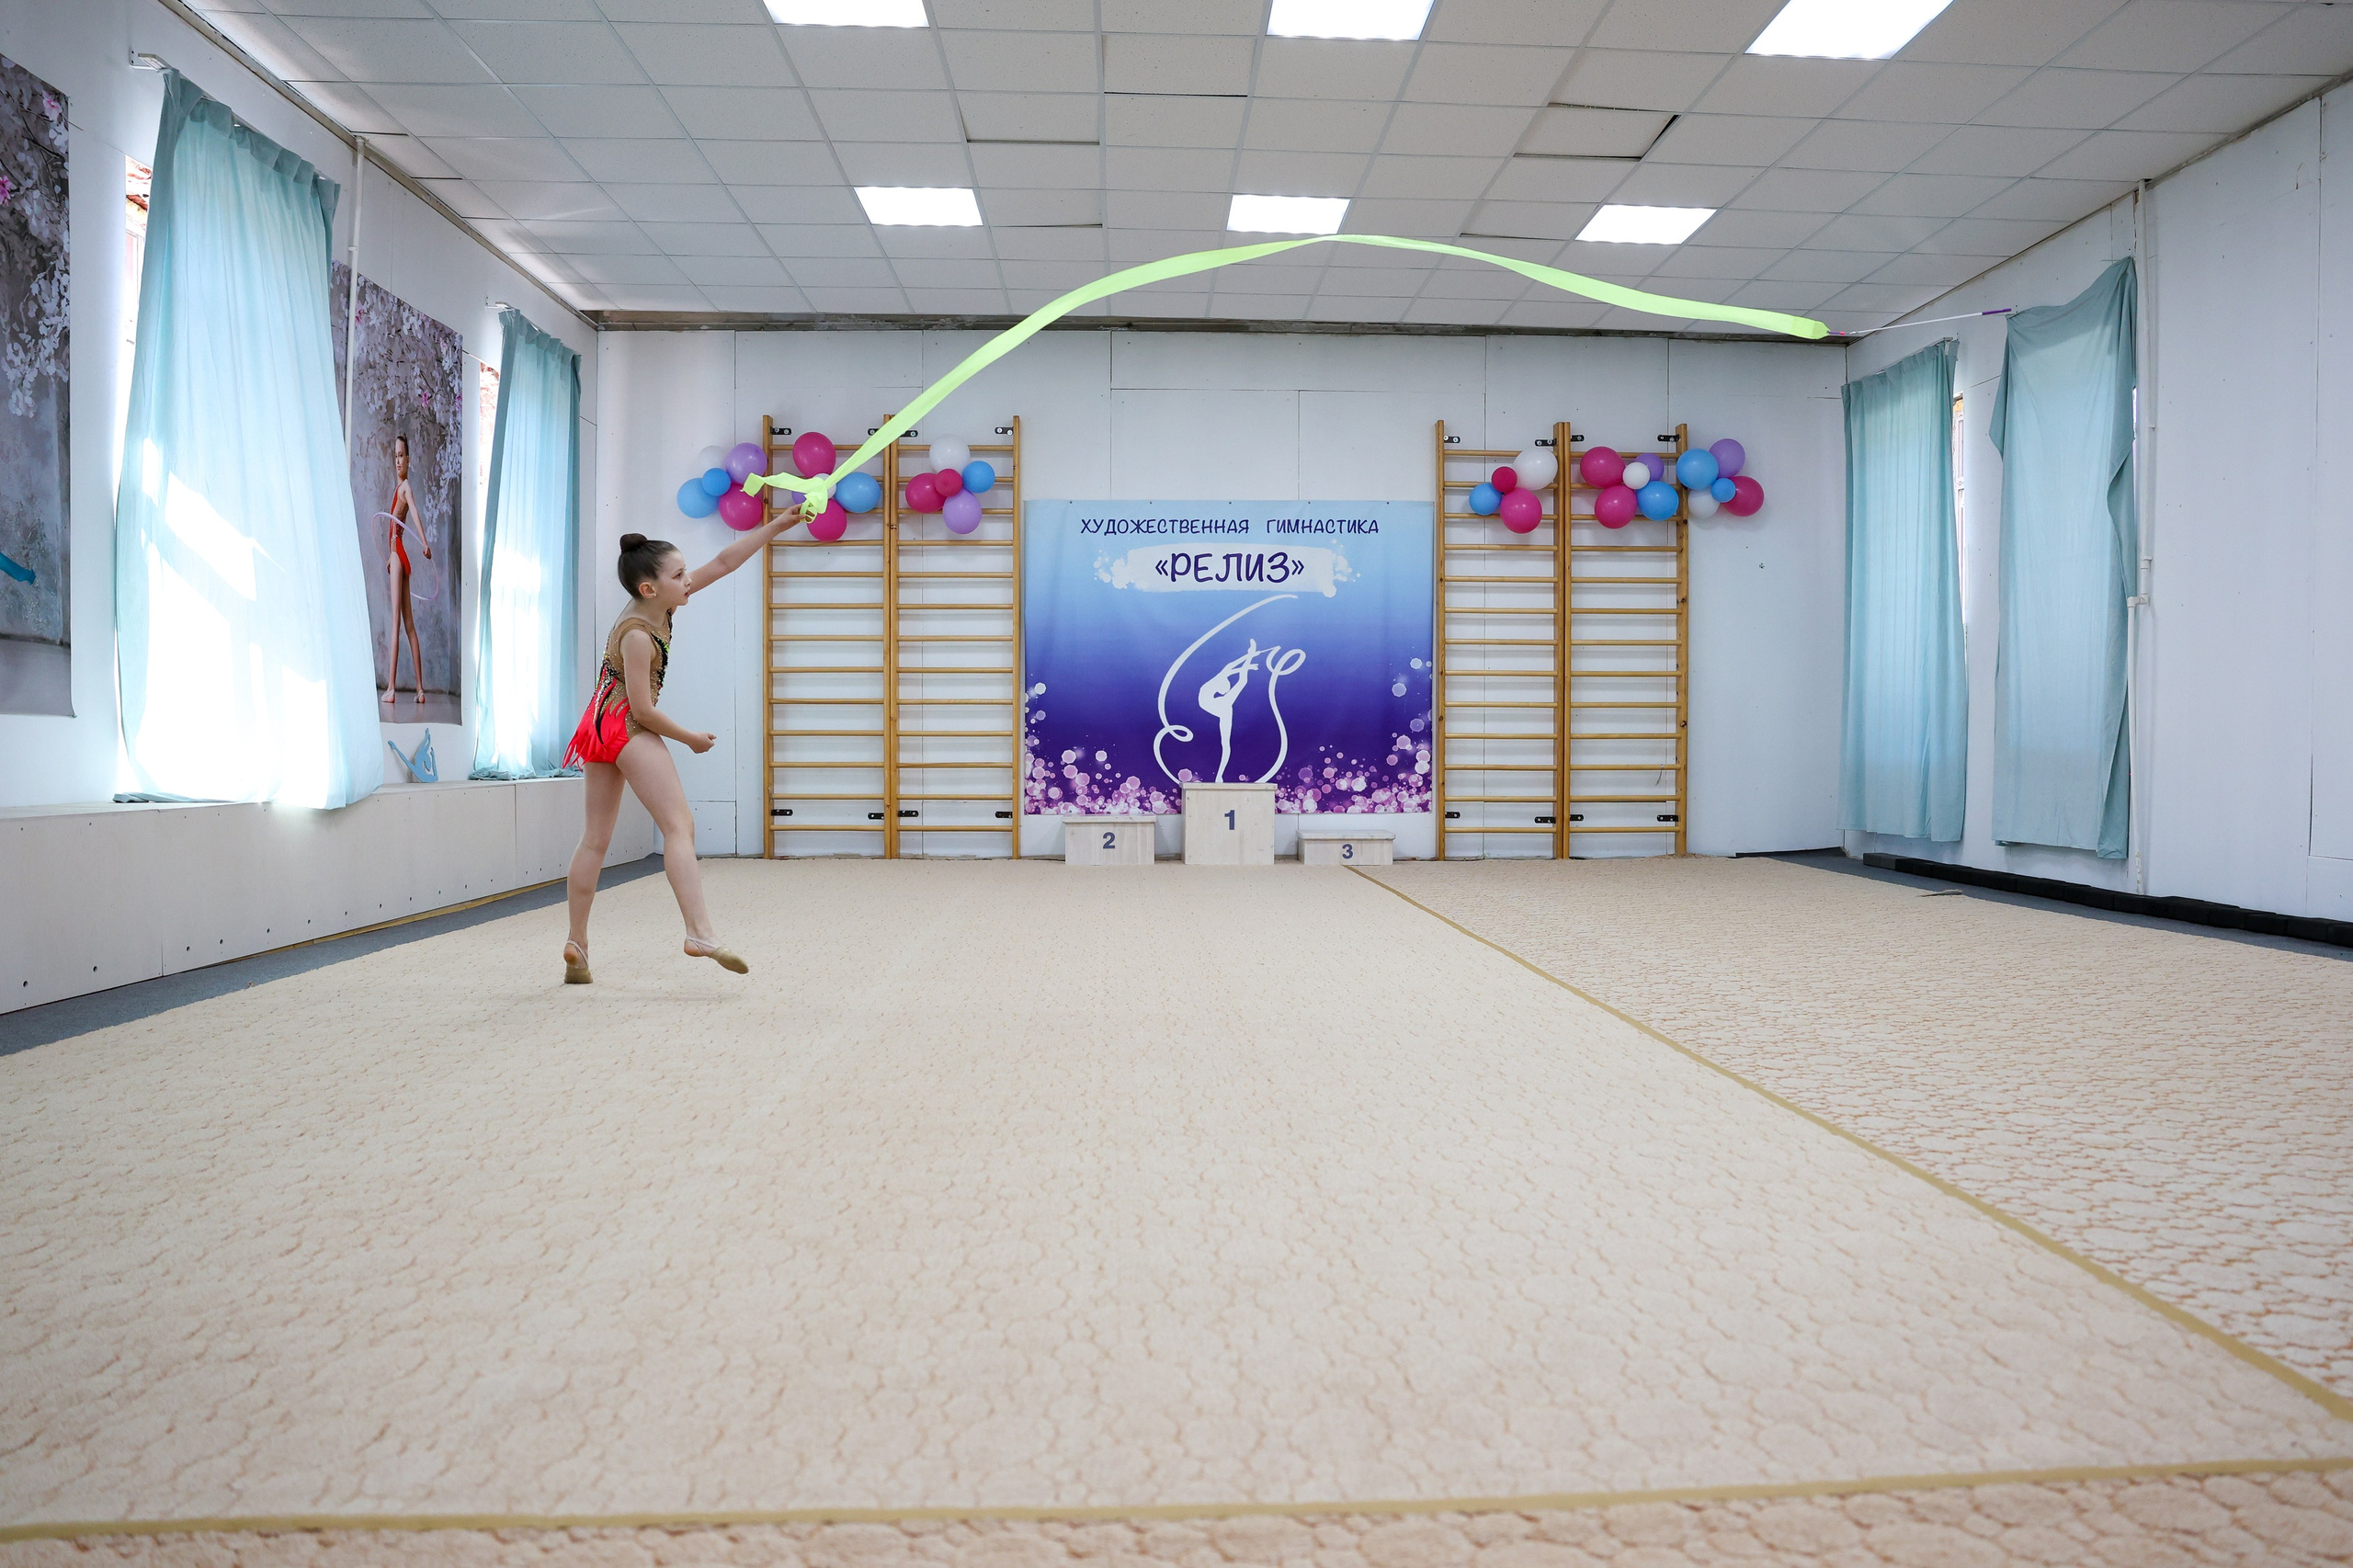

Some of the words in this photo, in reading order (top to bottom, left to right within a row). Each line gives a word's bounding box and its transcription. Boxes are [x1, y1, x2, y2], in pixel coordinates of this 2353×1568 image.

[1080, 518, 1250, 536] ХУДОЖЕСТВЕННАЯ
[1266, 518, 1380, 535] ГИМНАСТИКА
[1155, 552, 1304, 583] «РЕЛИЗ»
[1224, 810, 1235, 830] 1
[1103, 832, 1115, 848] 2
[1342, 844, 1353, 858] 3
